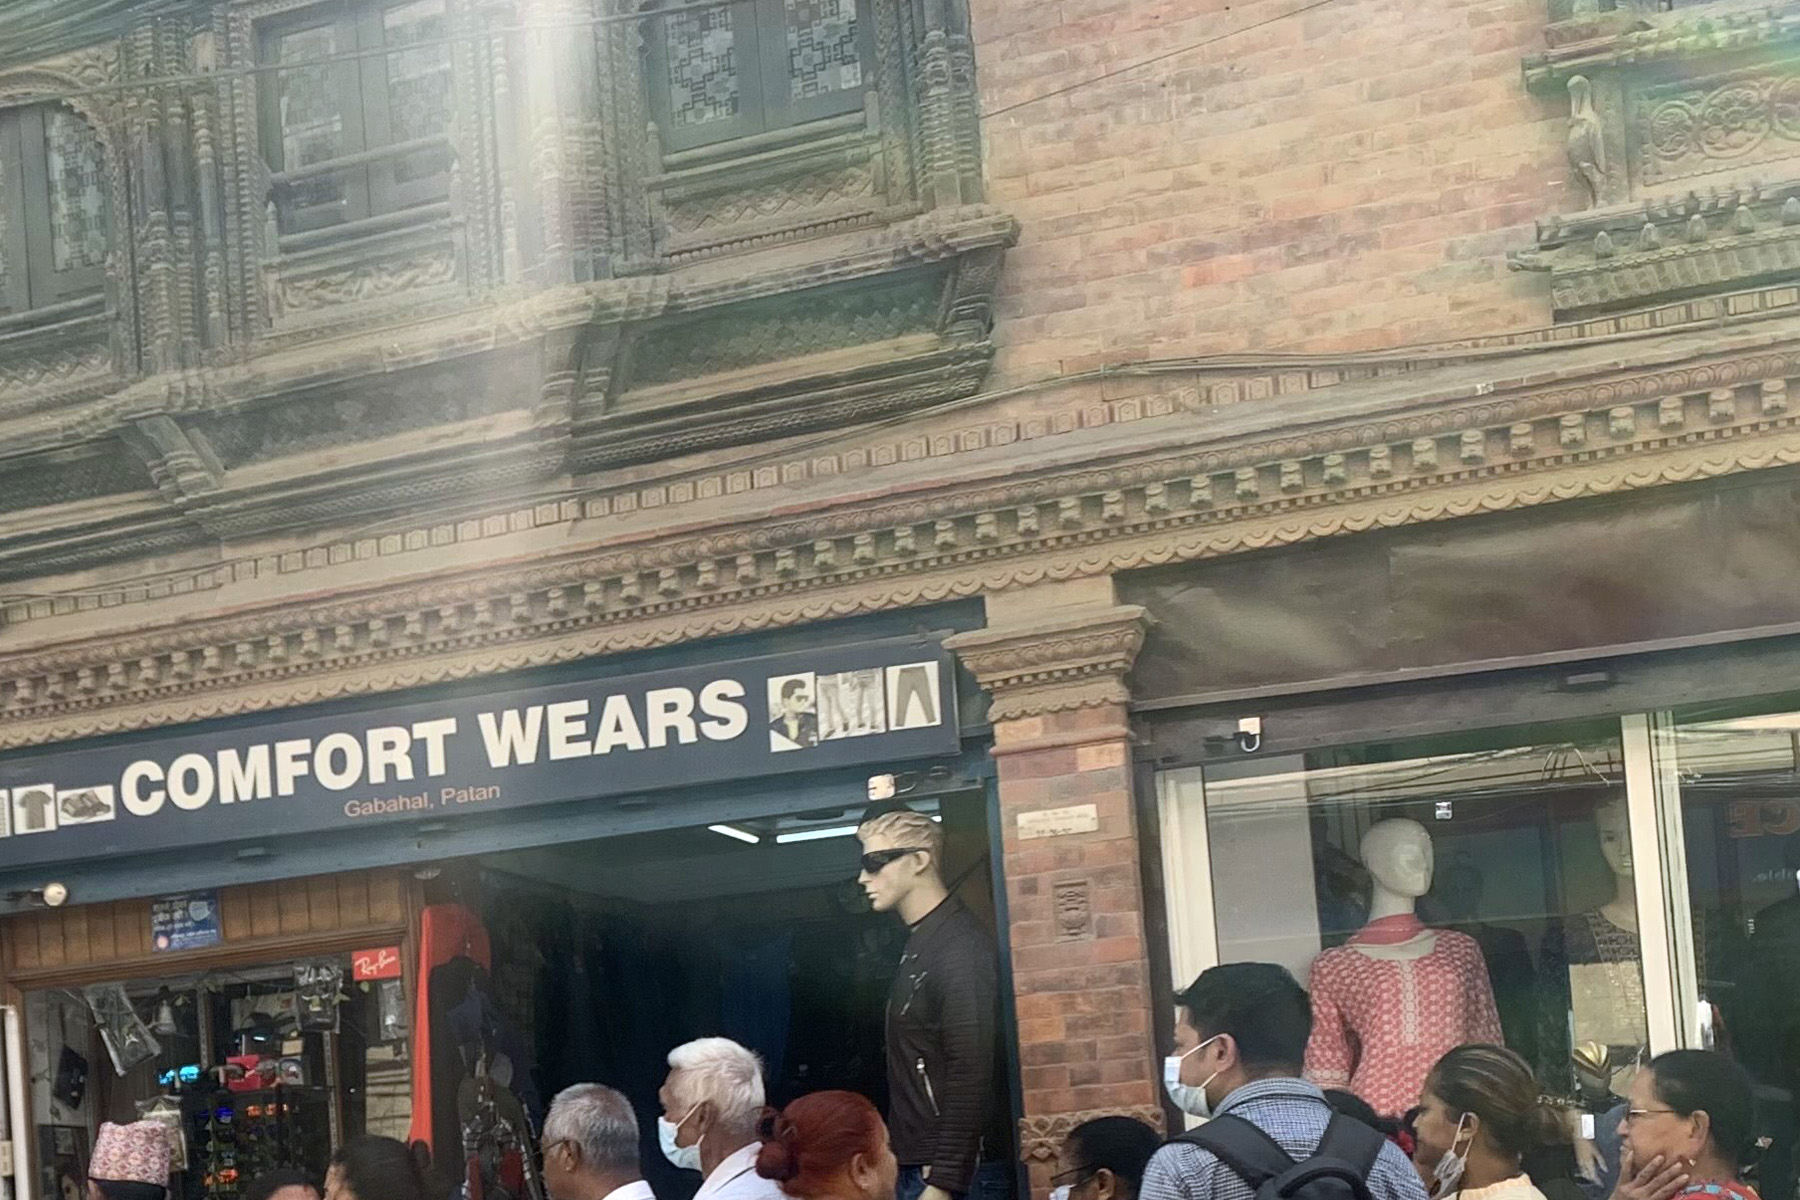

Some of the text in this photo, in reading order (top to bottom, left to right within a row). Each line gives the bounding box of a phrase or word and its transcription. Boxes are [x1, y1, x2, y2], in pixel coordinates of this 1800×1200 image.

[121, 677, 749, 817] COMFORT WEARS
[343, 784, 501, 817] Gabahal, Patan
